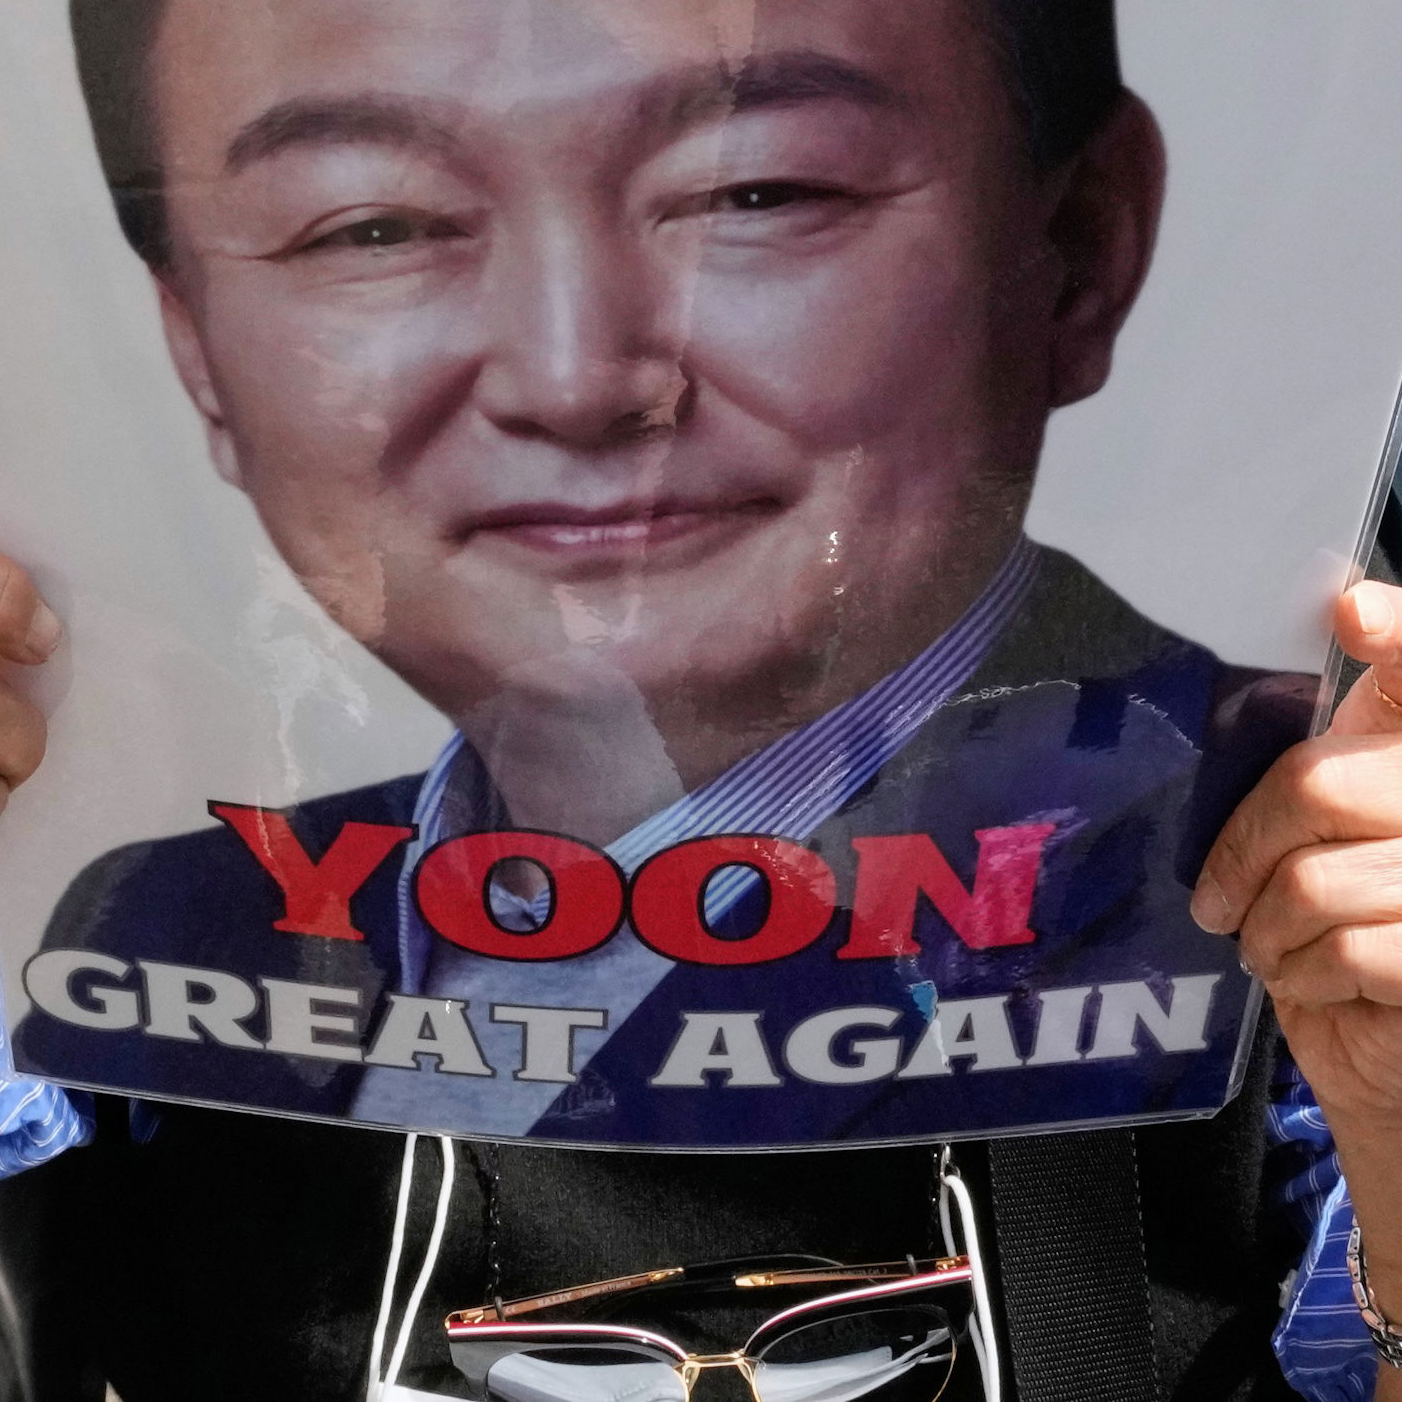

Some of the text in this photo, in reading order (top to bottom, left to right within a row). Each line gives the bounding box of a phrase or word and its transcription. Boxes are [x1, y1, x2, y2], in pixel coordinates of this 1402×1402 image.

[206, 799, 1043, 966] YOON
[21, 947, 1222, 1090] GREAT AGAIN
